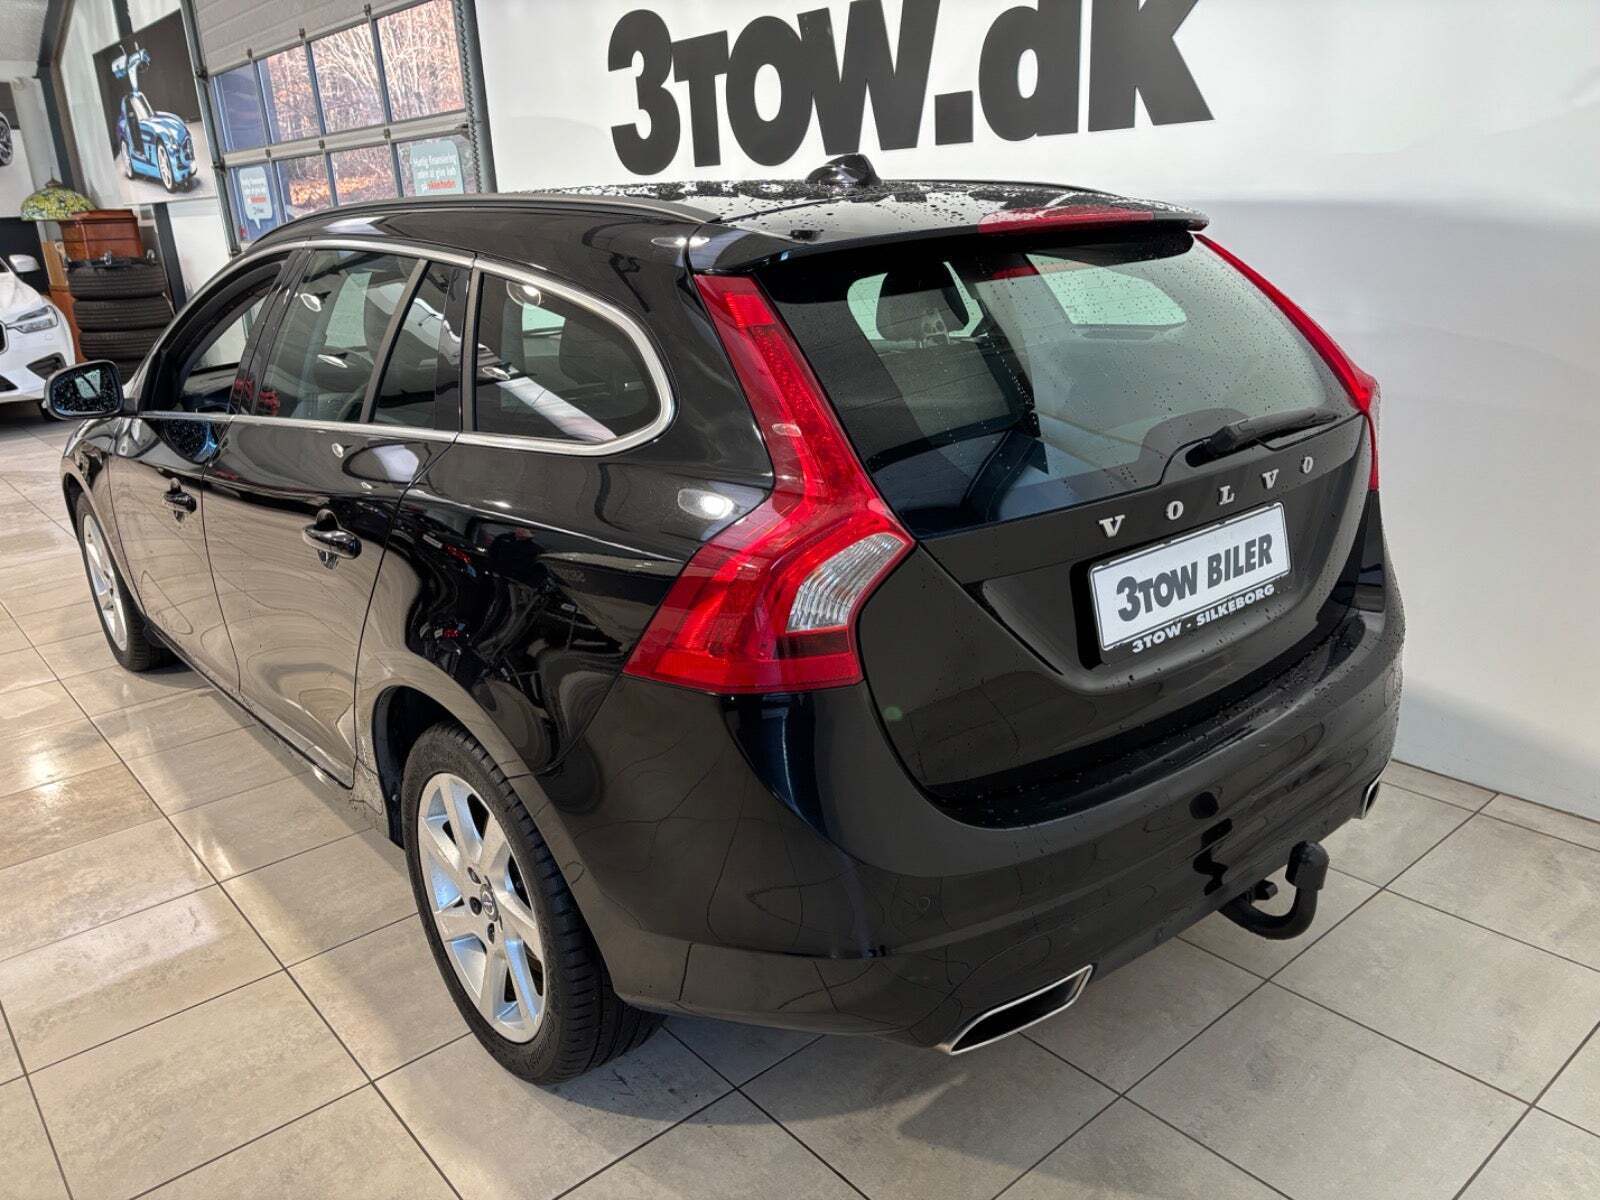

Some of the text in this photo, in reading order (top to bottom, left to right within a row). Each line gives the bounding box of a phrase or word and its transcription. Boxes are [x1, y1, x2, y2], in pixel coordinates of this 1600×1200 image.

[1099, 456, 1314, 538] VOLVO
[1116, 533, 1273, 622] 3TOW BILER
[1132, 622, 1182, 653] 3TOW
[1196, 583, 1275, 626] SILKEBORG
